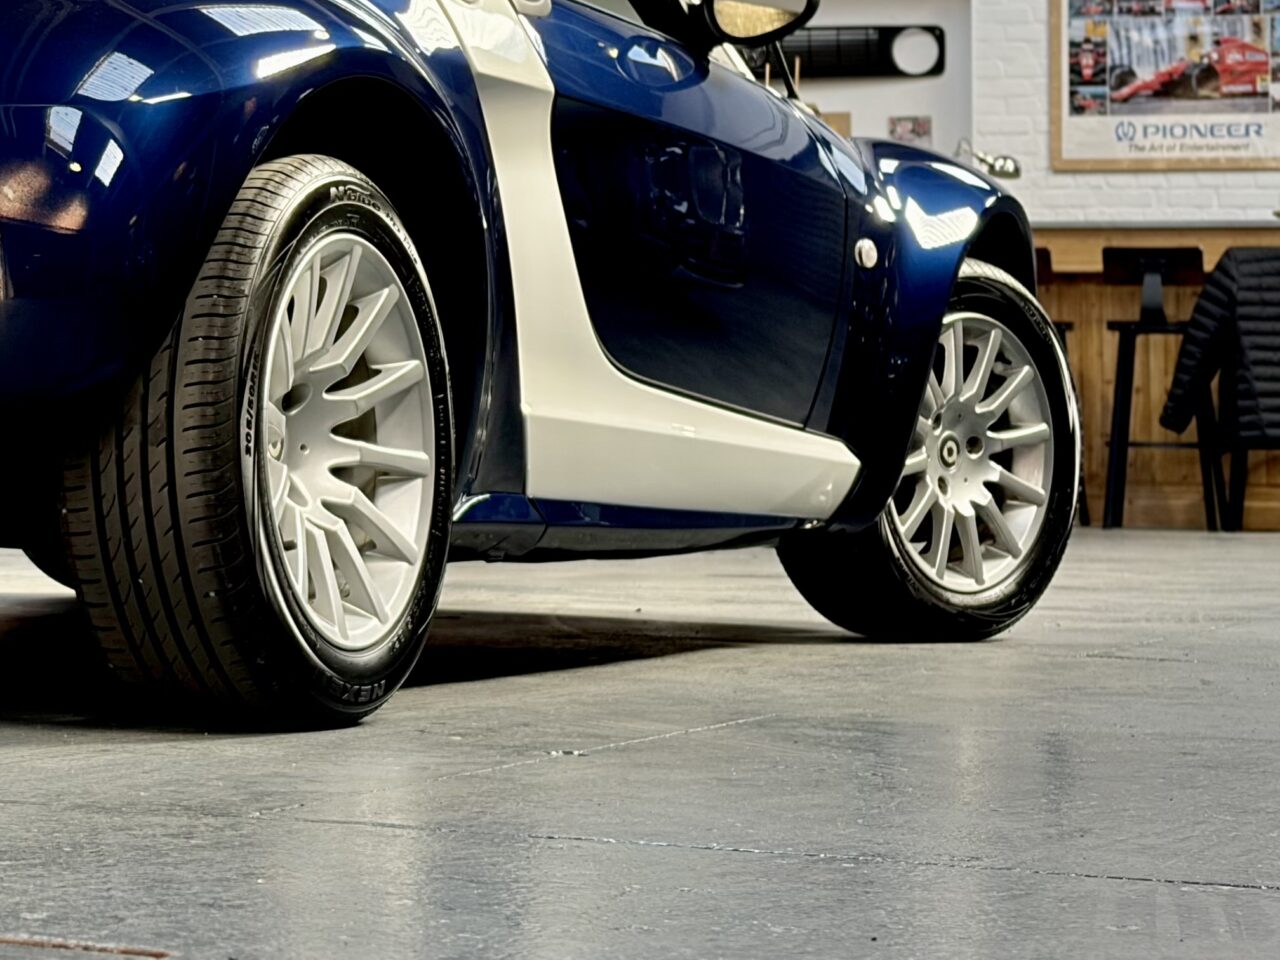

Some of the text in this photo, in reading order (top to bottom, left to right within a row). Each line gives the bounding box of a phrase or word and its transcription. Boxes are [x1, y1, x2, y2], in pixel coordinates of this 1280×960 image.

[1142, 122, 1263, 139] PIONEER
[1128, 142, 1250, 153] The Art of Entertainment
